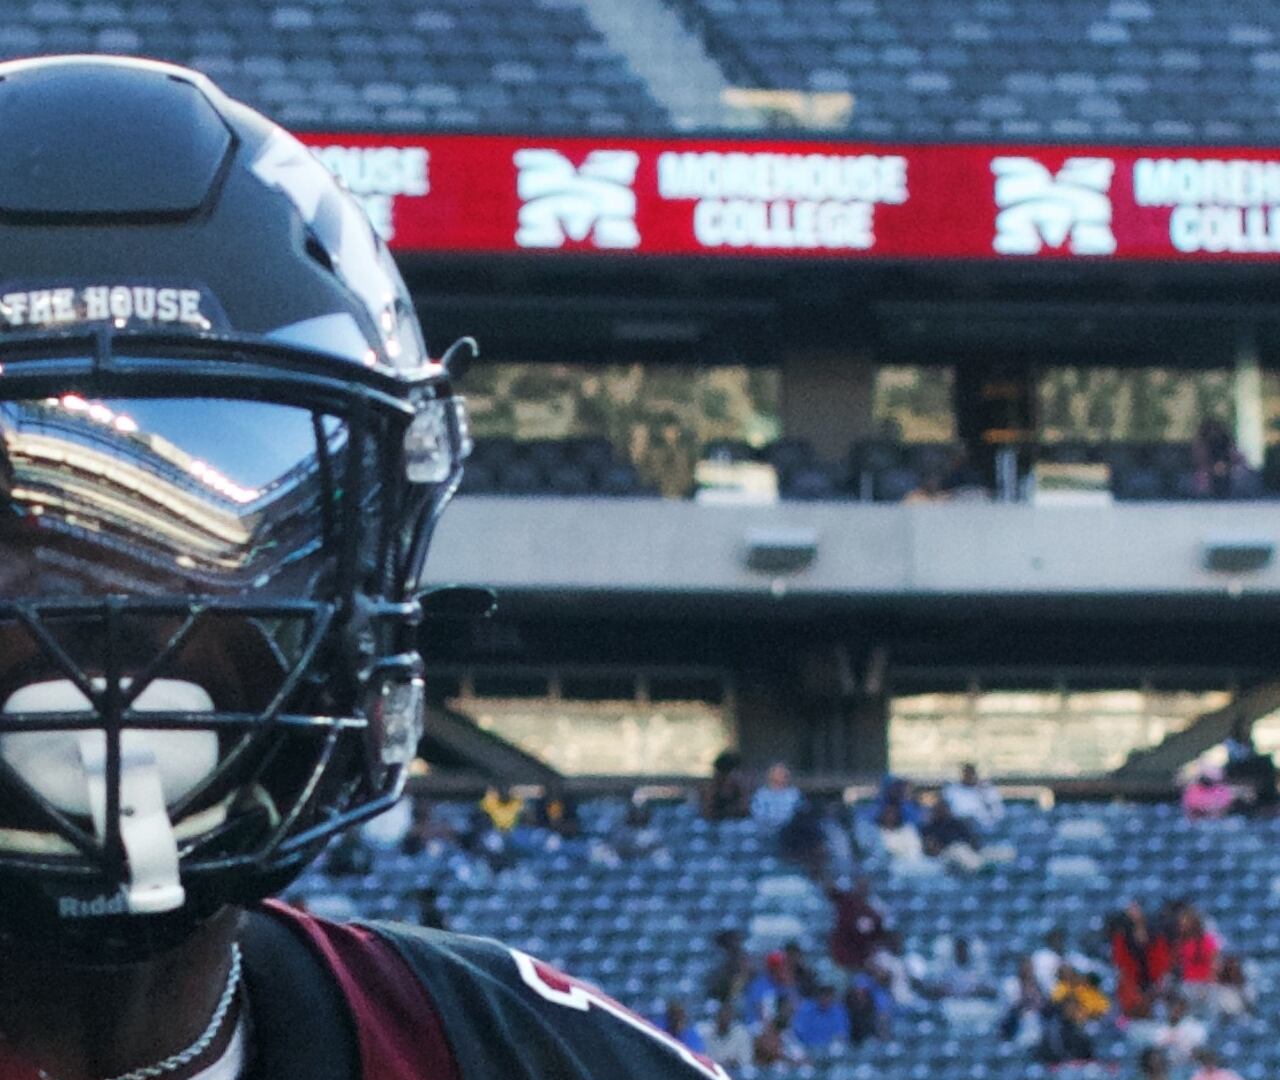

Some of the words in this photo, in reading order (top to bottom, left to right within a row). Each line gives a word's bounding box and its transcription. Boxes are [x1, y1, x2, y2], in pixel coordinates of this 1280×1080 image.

[657, 151, 909, 204] MOREHOUSE
[694, 199, 876, 249] COLLEGE
[4, 288, 77, 325] THE
[85, 286, 202, 323] HOUSE
